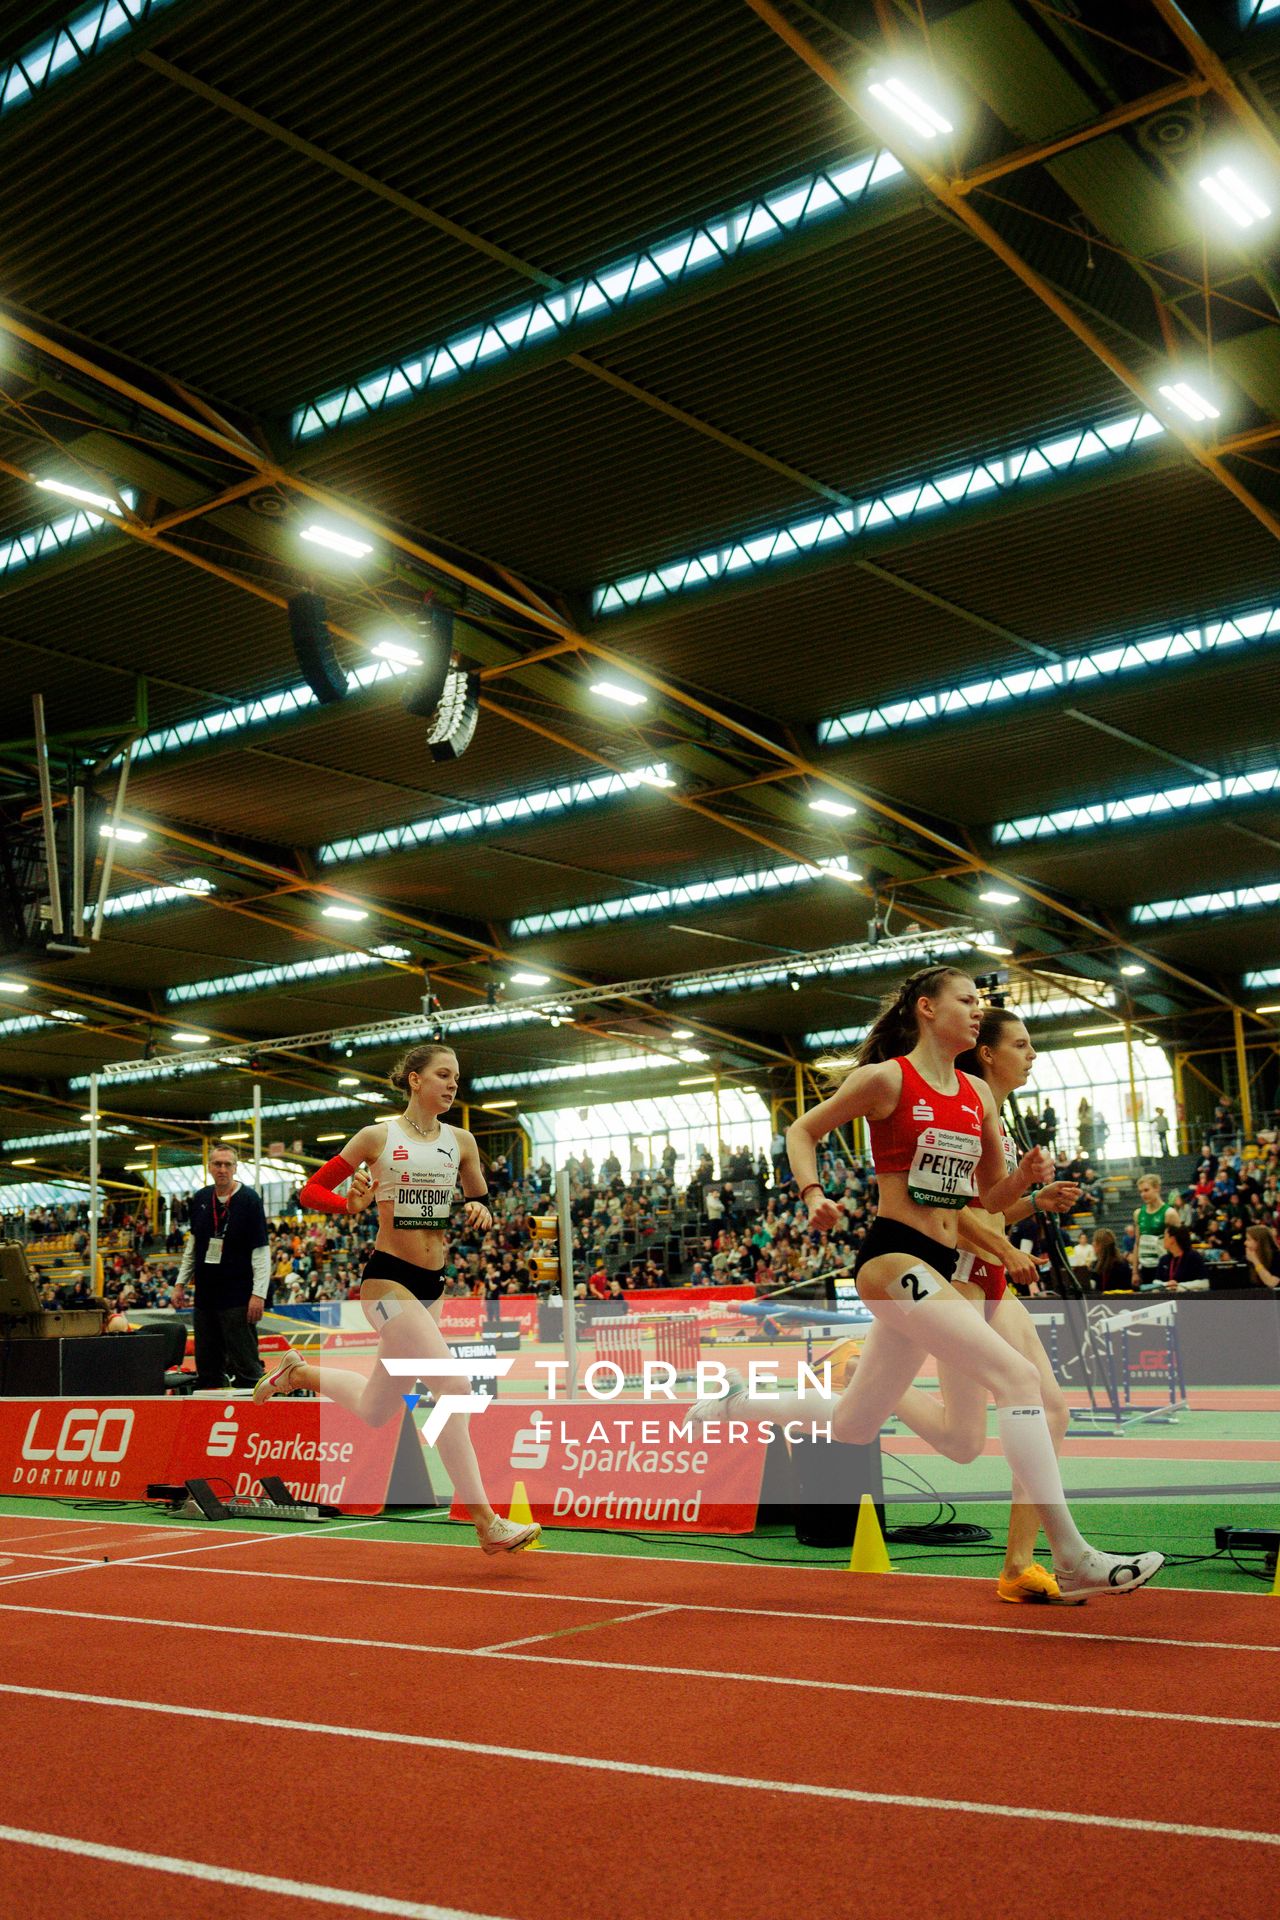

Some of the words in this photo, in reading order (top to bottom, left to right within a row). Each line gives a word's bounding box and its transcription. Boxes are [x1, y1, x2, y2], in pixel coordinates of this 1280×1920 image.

[937, 1140, 963, 1150] Dortmund
[955, 1135, 975, 1146] Meeting
[918, 1152, 974, 1179] PELTZER
[941, 1177, 958, 1193] 141
[399, 1219, 433, 1227] DORTMUND
[421, 1205, 434, 1217] 38
[901, 1273, 929, 1303] 2
[375, 1300, 389, 1321] 1
[21, 1408, 136, 1463] LGO
[243, 1433, 353, 1465] Sparkasse
[561, 1441, 708, 1479] Sparkasse
[13, 1467, 121, 1488] DORTMUND
[235, 1472, 346, 1504] Domund
[553, 1486, 702, 1523] Dortmund
